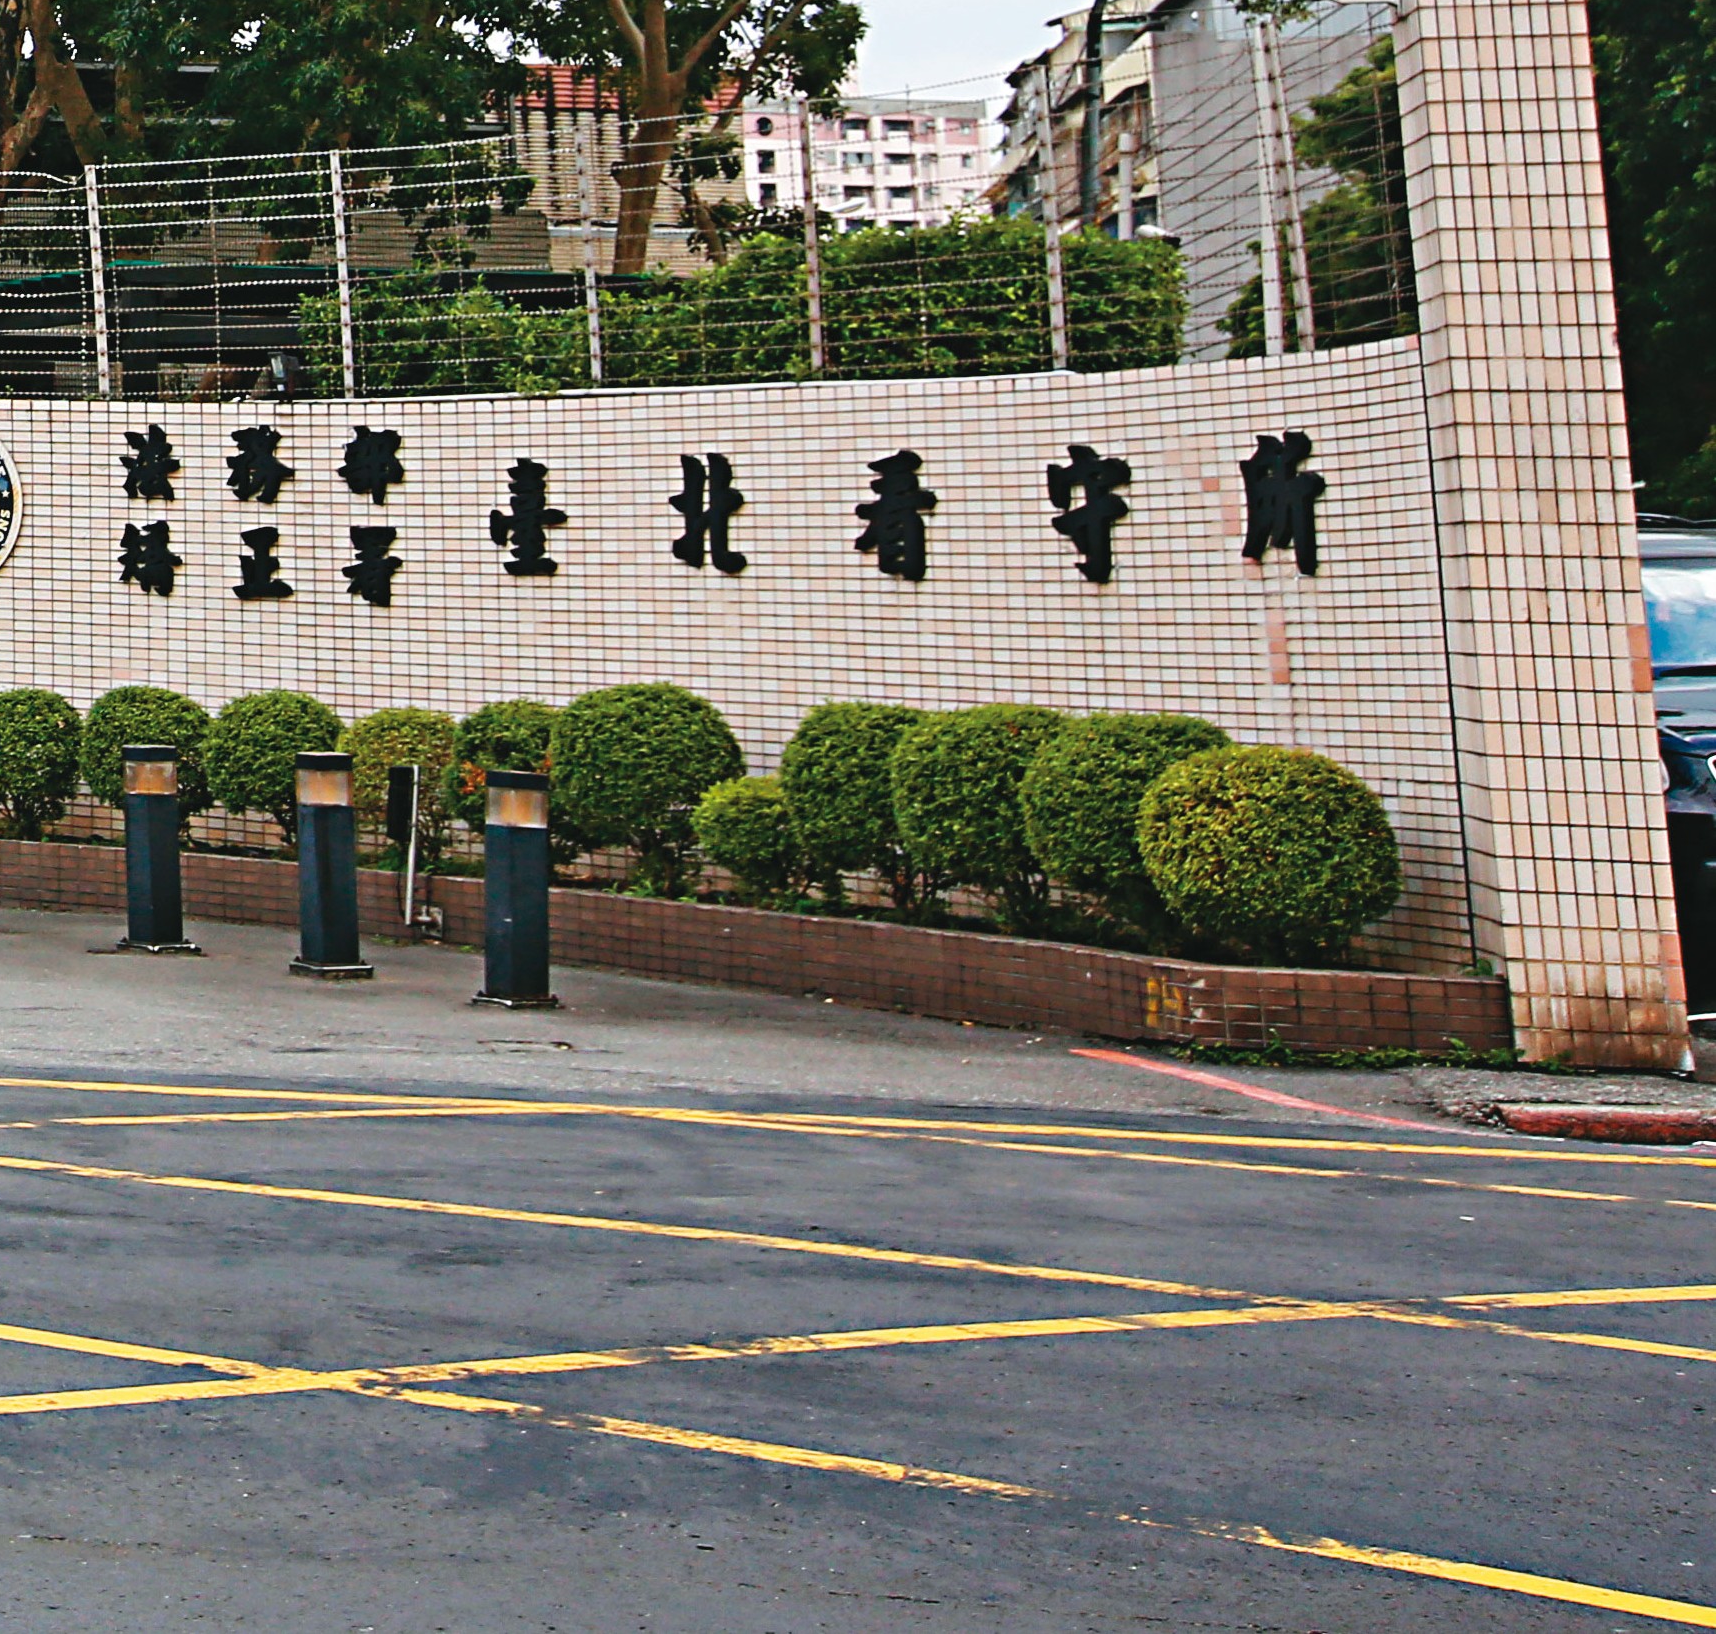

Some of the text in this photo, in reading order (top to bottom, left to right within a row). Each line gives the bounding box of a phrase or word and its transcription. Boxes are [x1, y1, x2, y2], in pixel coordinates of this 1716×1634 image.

[118, 423, 406, 506] 法務部
[489, 430, 1328, 586] 臺北看守所
[116, 519, 404, 608] 矯正署
